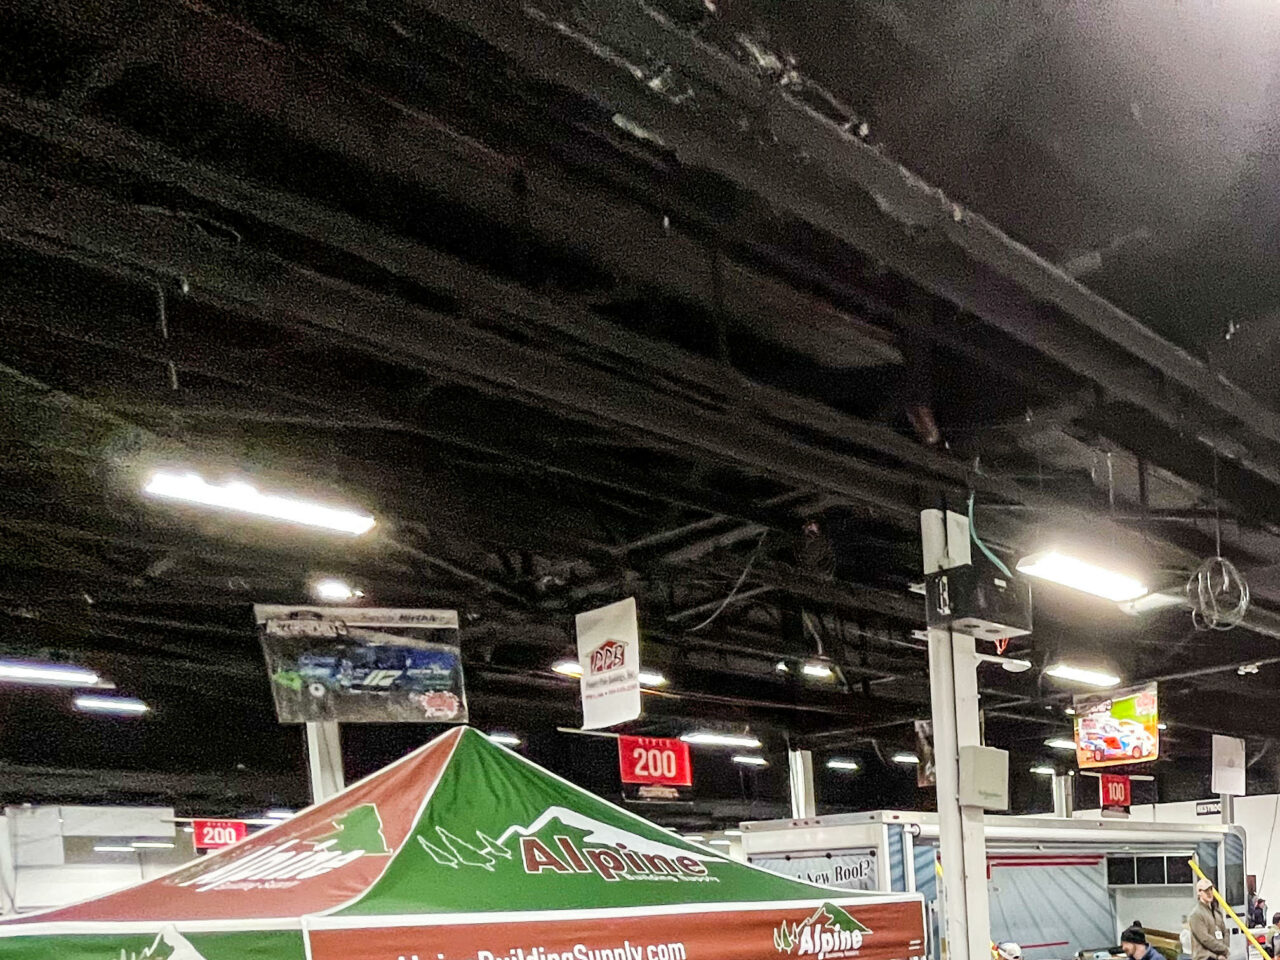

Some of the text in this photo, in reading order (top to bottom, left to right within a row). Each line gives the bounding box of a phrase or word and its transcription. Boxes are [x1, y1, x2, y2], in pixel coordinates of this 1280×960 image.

[632, 749, 677, 778] 200
[1108, 782, 1125, 801] 100
[202, 827, 237, 845] 200
[519, 835, 709, 882] Alpine
[834, 859, 871, 882] Roof?
[797, 922, 863, 960] Alpine
